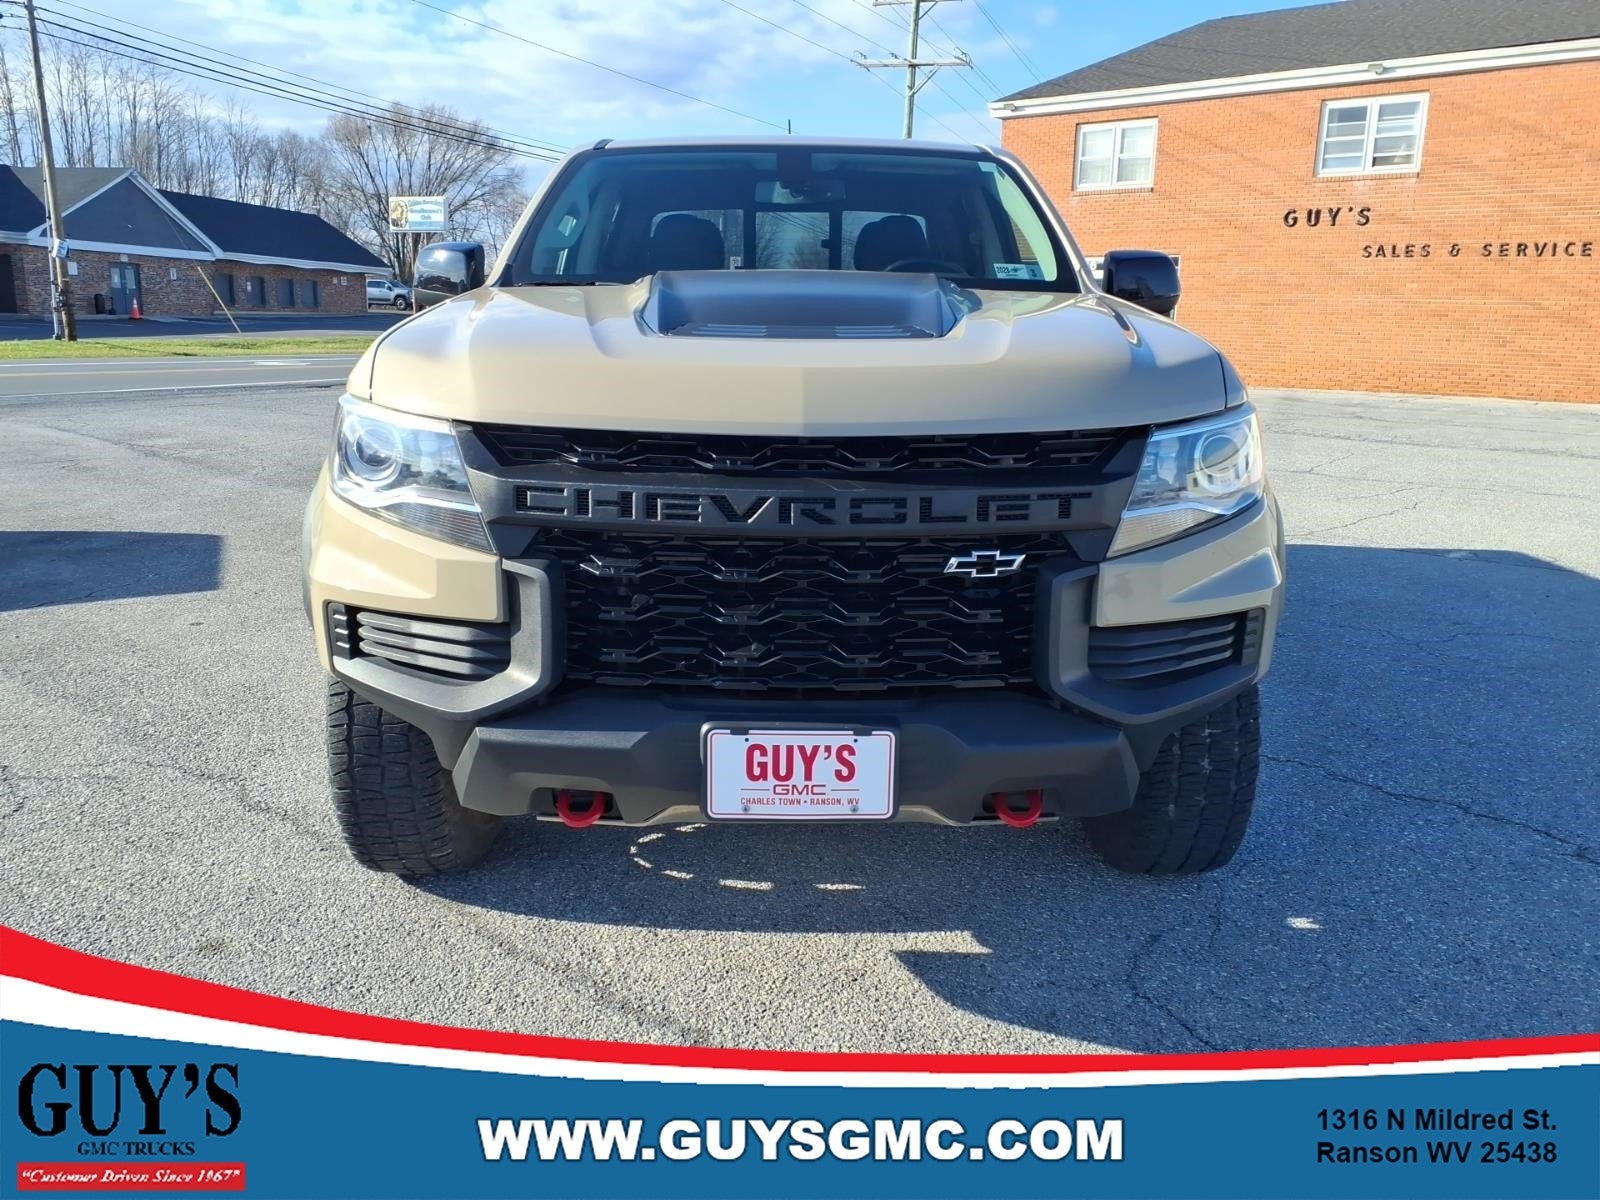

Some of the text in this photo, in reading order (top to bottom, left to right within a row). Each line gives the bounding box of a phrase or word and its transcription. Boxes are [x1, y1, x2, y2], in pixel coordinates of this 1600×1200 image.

[1282, 206, 1372, 228] GUY'S
[1361, 241, 1594, 259] SALES & SERVICE
[515, 486, 1092, 524] CHEVROLET
[745, 743, 857, 783] GUY'S
[772, 784, 827, 796] GMC
[740, 796, 860, 807] CHARLES TOWN RANSON, WV
